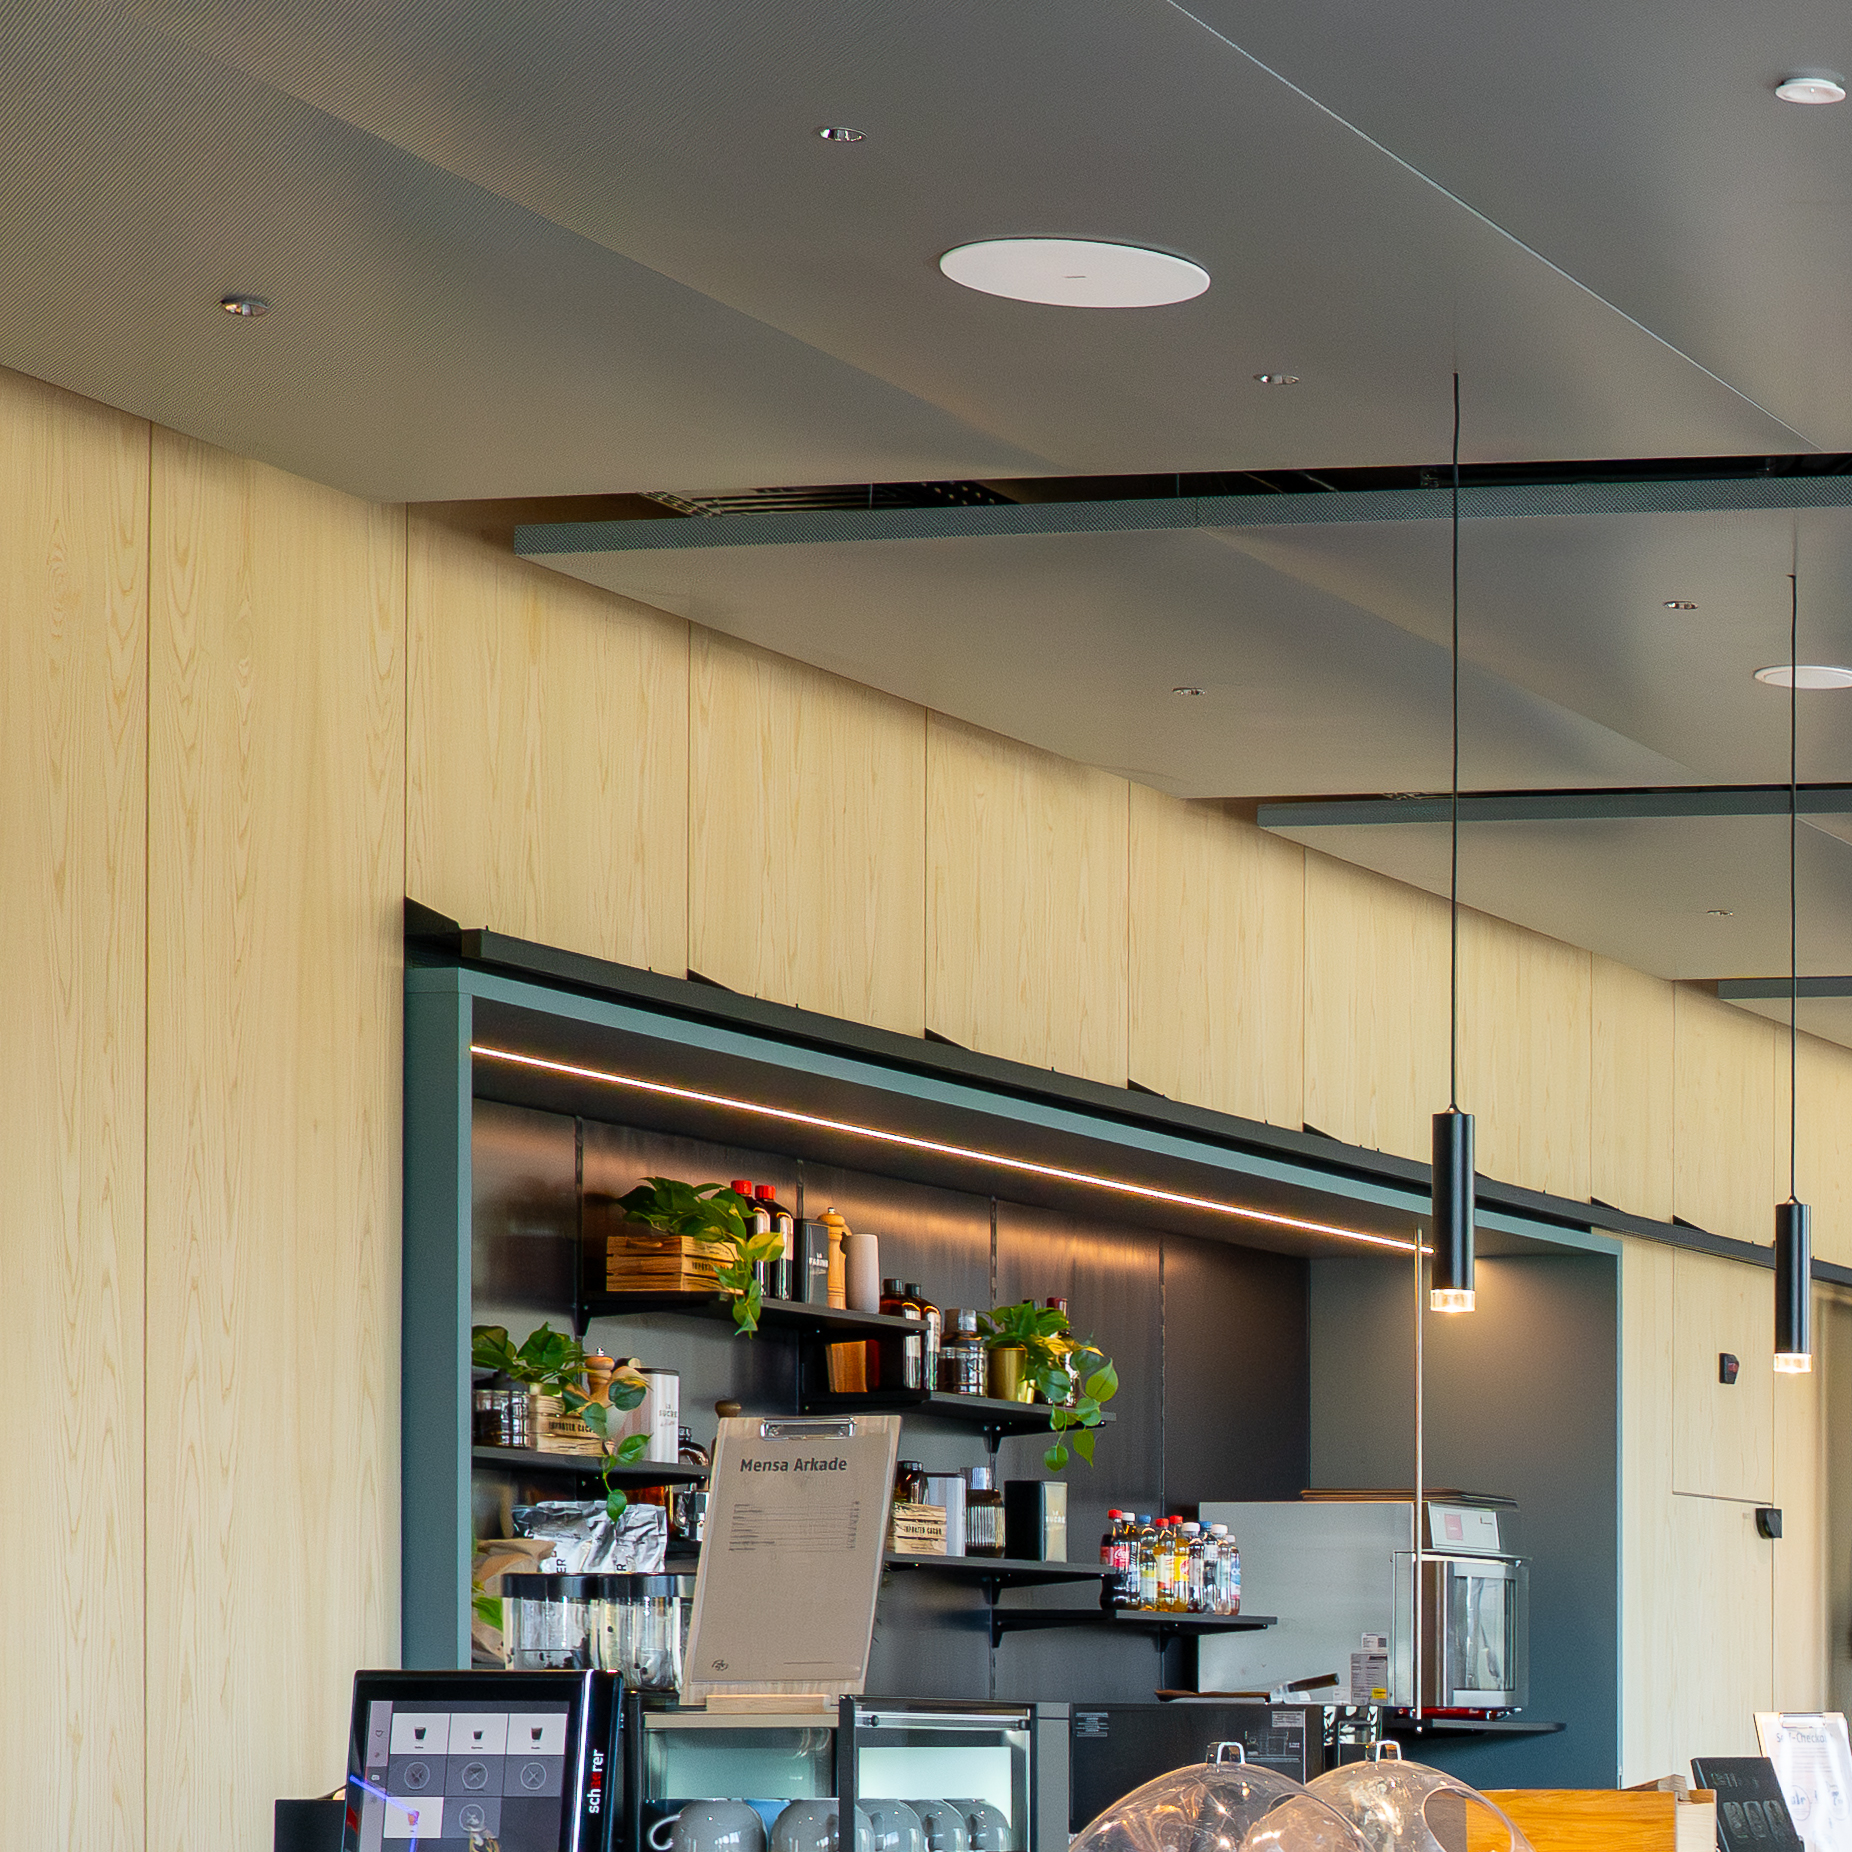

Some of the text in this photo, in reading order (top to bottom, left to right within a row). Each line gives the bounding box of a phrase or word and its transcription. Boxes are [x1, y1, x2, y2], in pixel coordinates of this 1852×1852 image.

[740, 1456, 847, 1472] Mensa Arkade
[589, 1749, 605, 1814] schaerer
